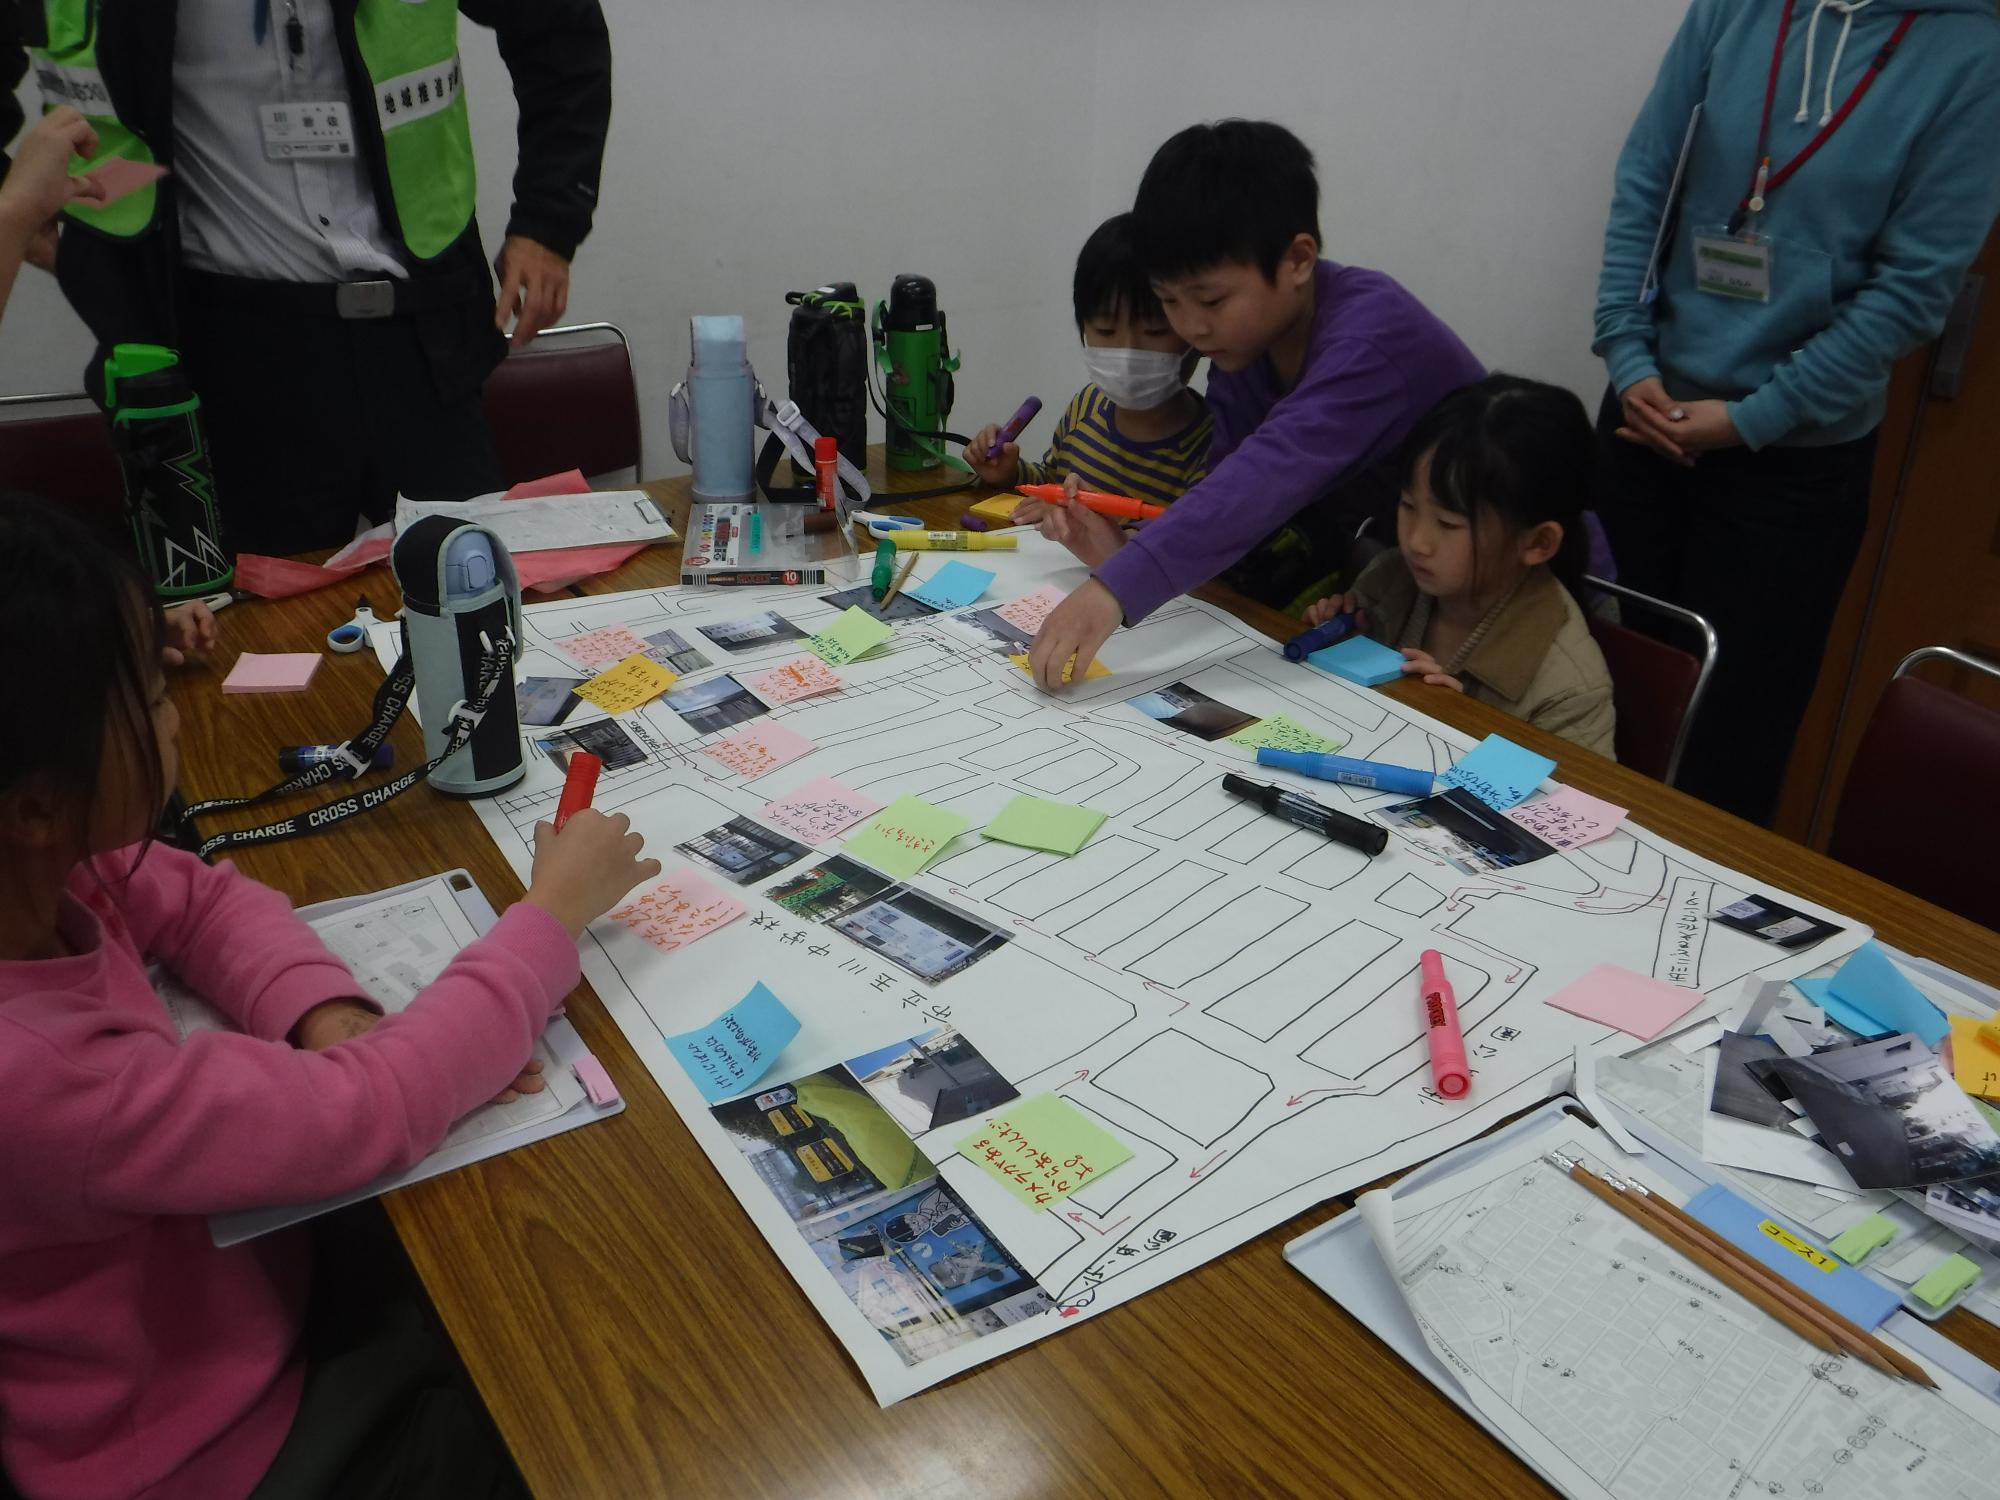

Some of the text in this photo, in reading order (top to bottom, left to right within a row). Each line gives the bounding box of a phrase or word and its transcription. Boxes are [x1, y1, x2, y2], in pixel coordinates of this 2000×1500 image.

[362, 696, 402, 748] CHARGE
[232, 820, 295, 841] CHARGE
[308, 799, 358, 826] CROSS
[362, 772, 415, 806] CHARGE
[749, 911, 952, 1025] 市立玉川中学校
[973, 1138, 1054, 1205] カメラがある
[1765, 1224, 1828, 1266] コース1
